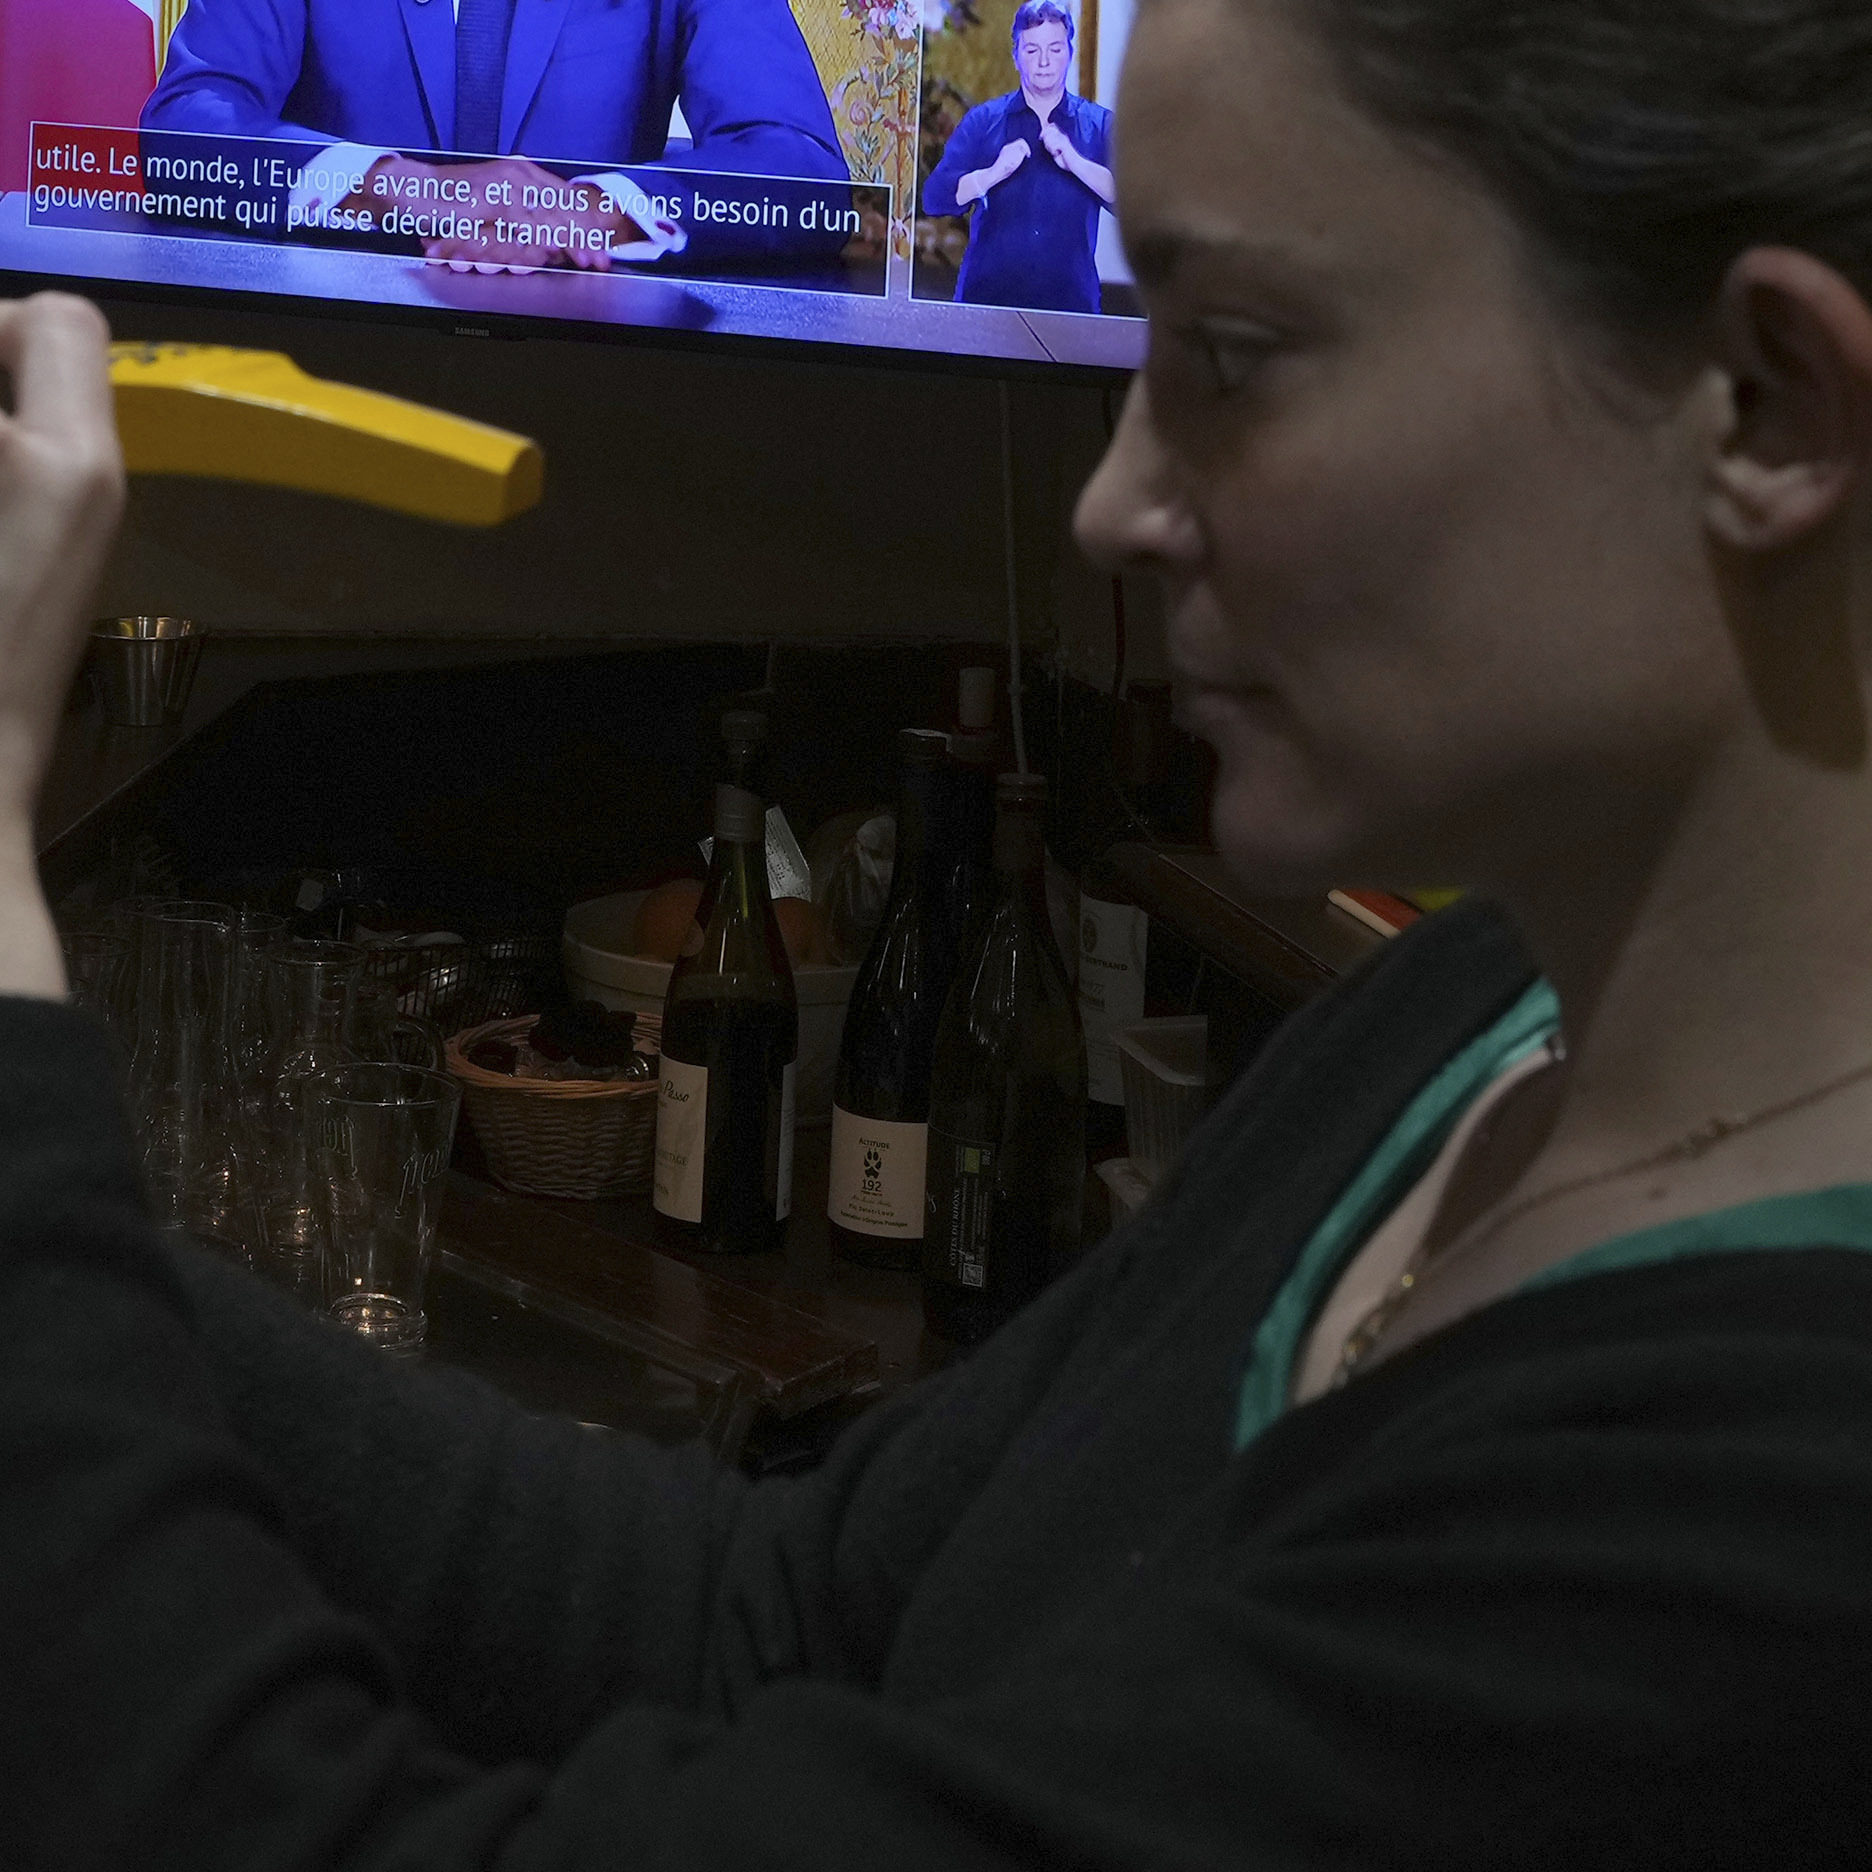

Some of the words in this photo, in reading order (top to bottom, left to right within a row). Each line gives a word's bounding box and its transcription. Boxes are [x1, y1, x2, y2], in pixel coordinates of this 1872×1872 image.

[34, 183, 226, 220] gouvernement
[235, 197, 277, 230] qui
[287, 202, 373, 233] puisse
[382, 205, 488, 244] décider,
[495, 220, 619, 251] trancher.
[35, 145, 101, 175] utile.
[108, 147, 138, 177] Le
[146, 154, 245, 192] monde,
[252, 158, 364, 201] l'Europe
[372, 172, 478, 208] avance,
[488, 181, 511, 205] et
[522, 184, 589, 213] nous
[598, 190, 683, 220] avons
[693, 191, 788, 227] besoin
[799, 199, 861, 233] d'un
[861, 1178, 882, 1192] 192
